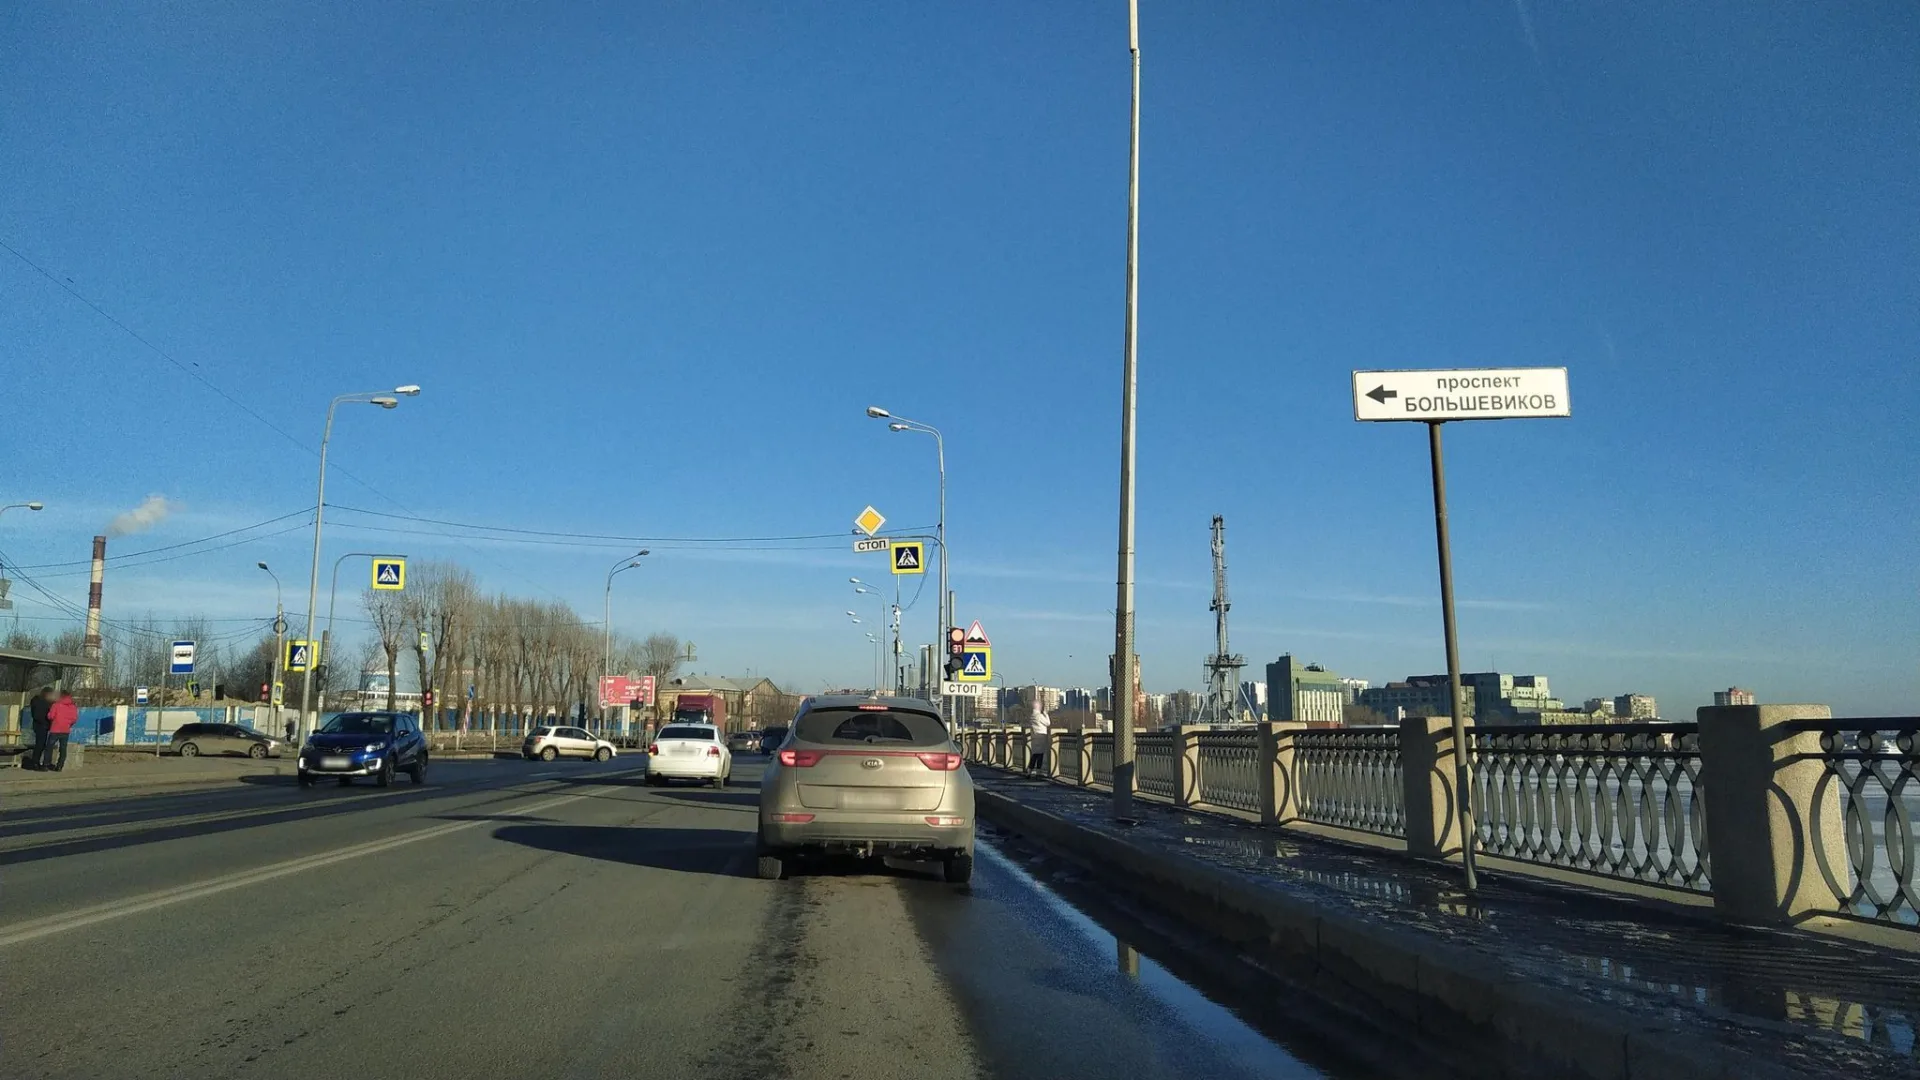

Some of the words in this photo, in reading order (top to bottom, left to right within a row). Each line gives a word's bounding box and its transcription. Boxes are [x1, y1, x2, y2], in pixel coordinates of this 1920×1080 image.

[1437, 376, 1521, 392] проспект
[1405, 395, 1556, 412] БОЛЬШЕВИКОВ
[858, 540, 886, 550] СТОП
[949, 684, 977, 693] СТОП
